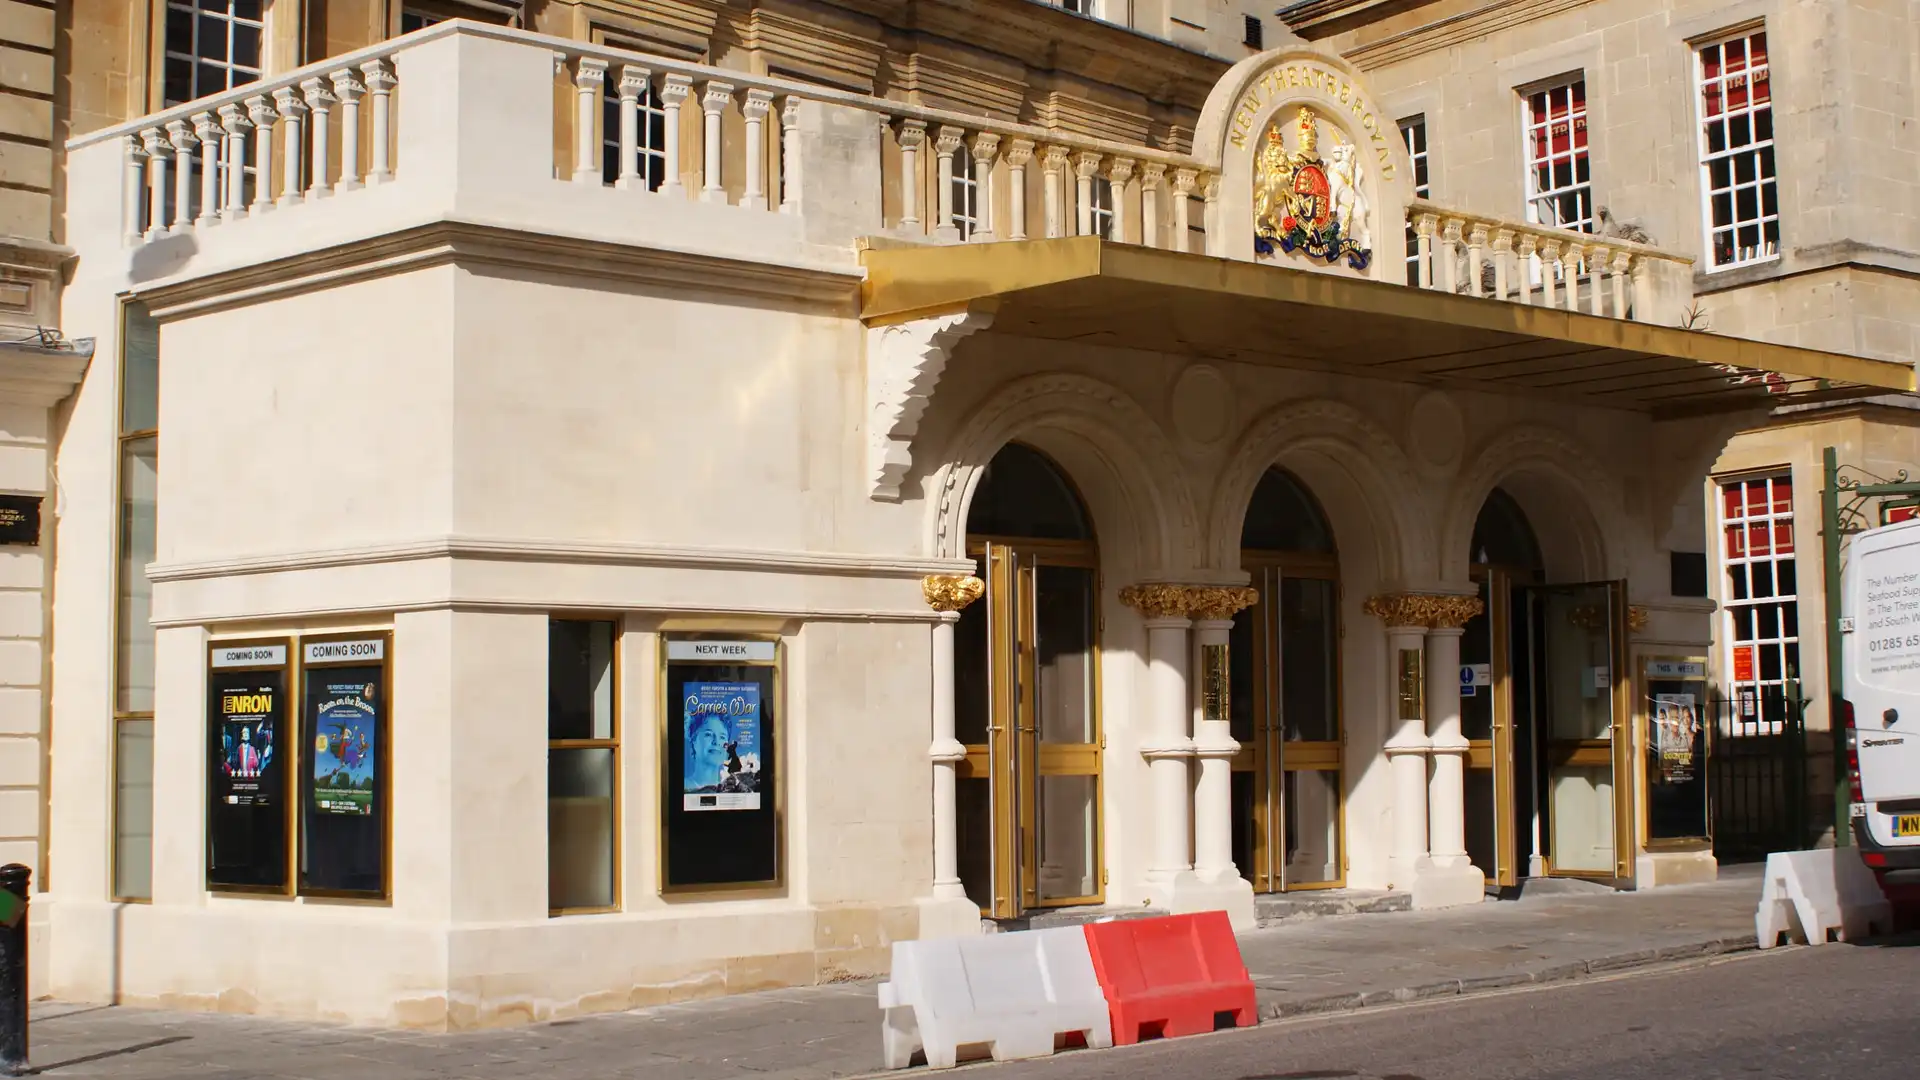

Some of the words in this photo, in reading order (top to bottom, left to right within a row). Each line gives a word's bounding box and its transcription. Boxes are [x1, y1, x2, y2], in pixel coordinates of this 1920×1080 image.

[1230, 89, 1263, 151] NEW
[1260, 65, 1353, 105] THEATRE
[1351, 97, 1396, 182] ROYAL
[1866, 578, 1881, 588] The
[1884, 573, 1918, 585] Number
[1867, 589, 1900, 602] Seafood
[1877, 604, 1892, 614] The
[1894, 600, 1919, 611] Three
[1868, 618, 1883, 629] and
[1885, 614, 1910, 627] South
[312, 646, 348, 658] COMING
[350, 643, 377, 656] SOON
[695, 645, 718, 654] NEXT
[721, 645, 746, 655] WEEK
[1869, 637, 1902, 652] 01285
[226, 651, 253, 661] COMING
[254, 650, 274, 660] SOON
[1656, 664, 1671, 673] THIS
[1676, 664, 1695, 673] WEEK
[318, 700, 336, 714] Room
[336, 698, 345, 706] on
[344, 695, 355, 706] the
[355, 696, 375, 715] Broom
[685, 692, 727, 716] Carrie's
[729, 696, 757, 716] War
[1901, 816, 1919, 833] WN
